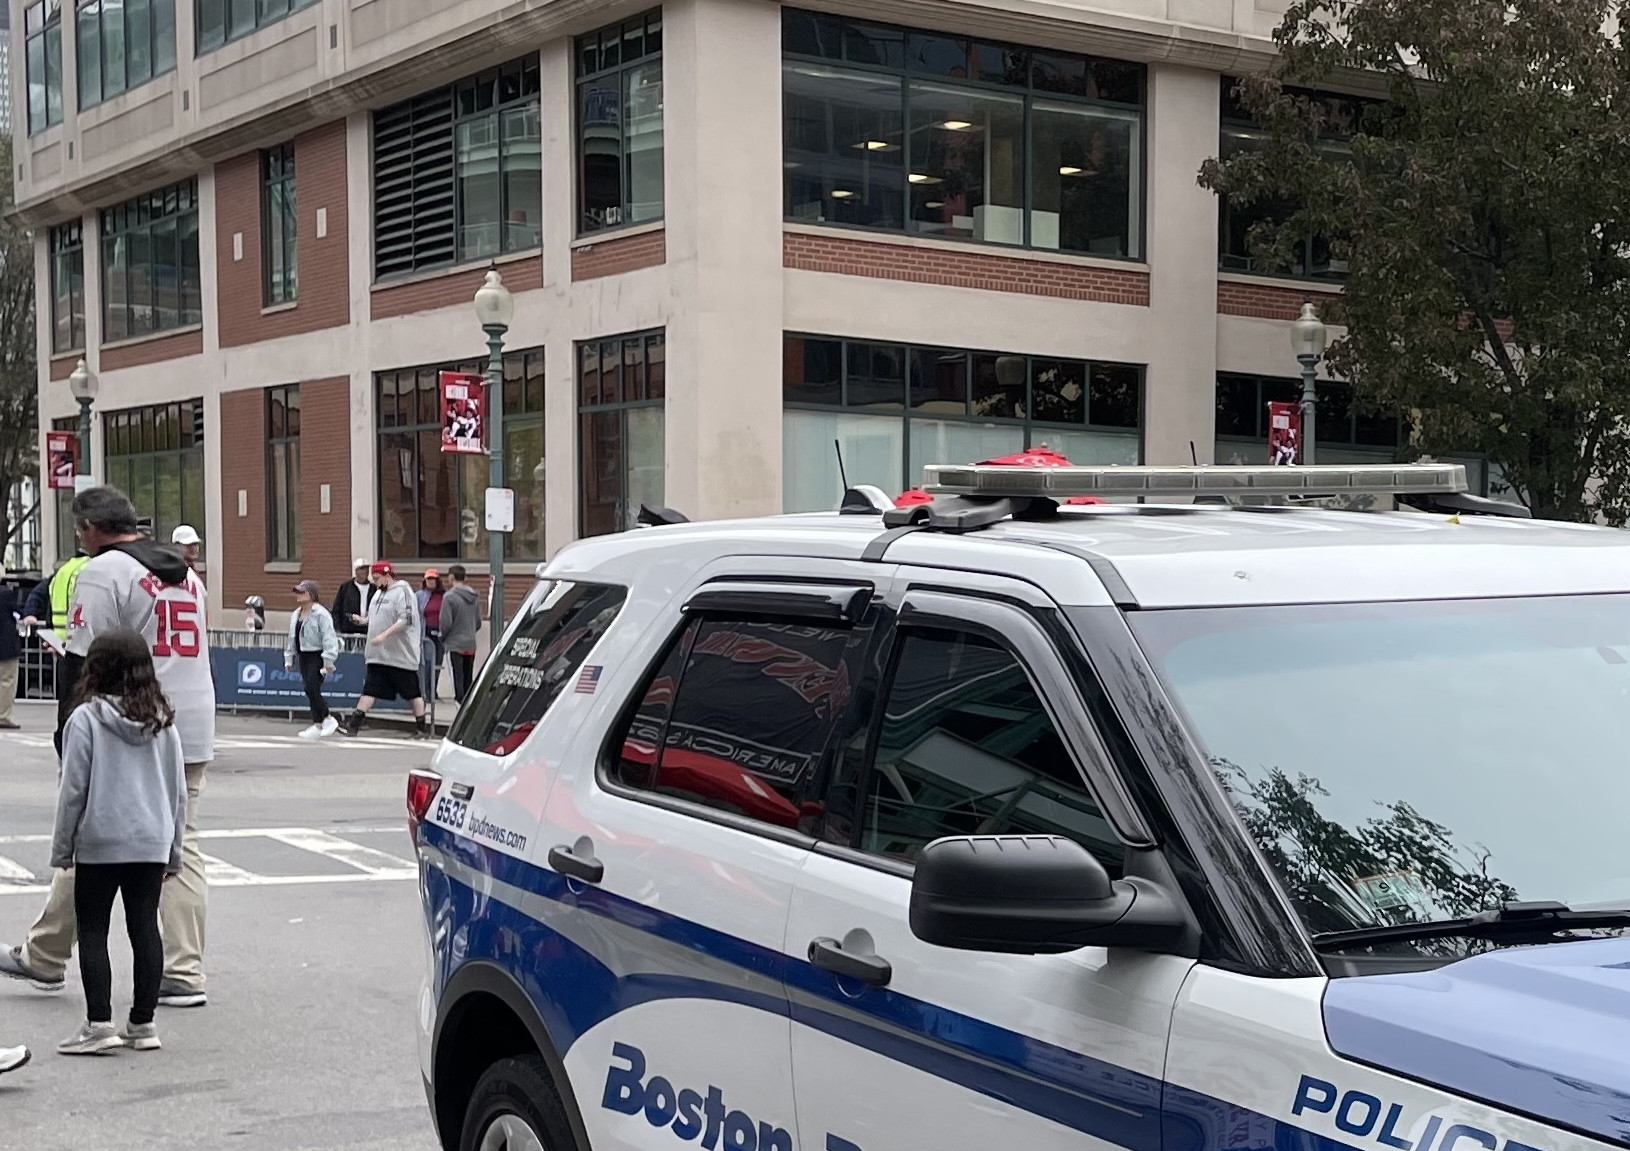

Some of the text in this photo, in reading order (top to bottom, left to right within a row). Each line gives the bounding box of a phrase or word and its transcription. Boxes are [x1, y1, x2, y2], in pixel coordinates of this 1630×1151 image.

[152, 600, 199, 657] 15
[436, 796, 527, 851] 6533 bpdnews.com
